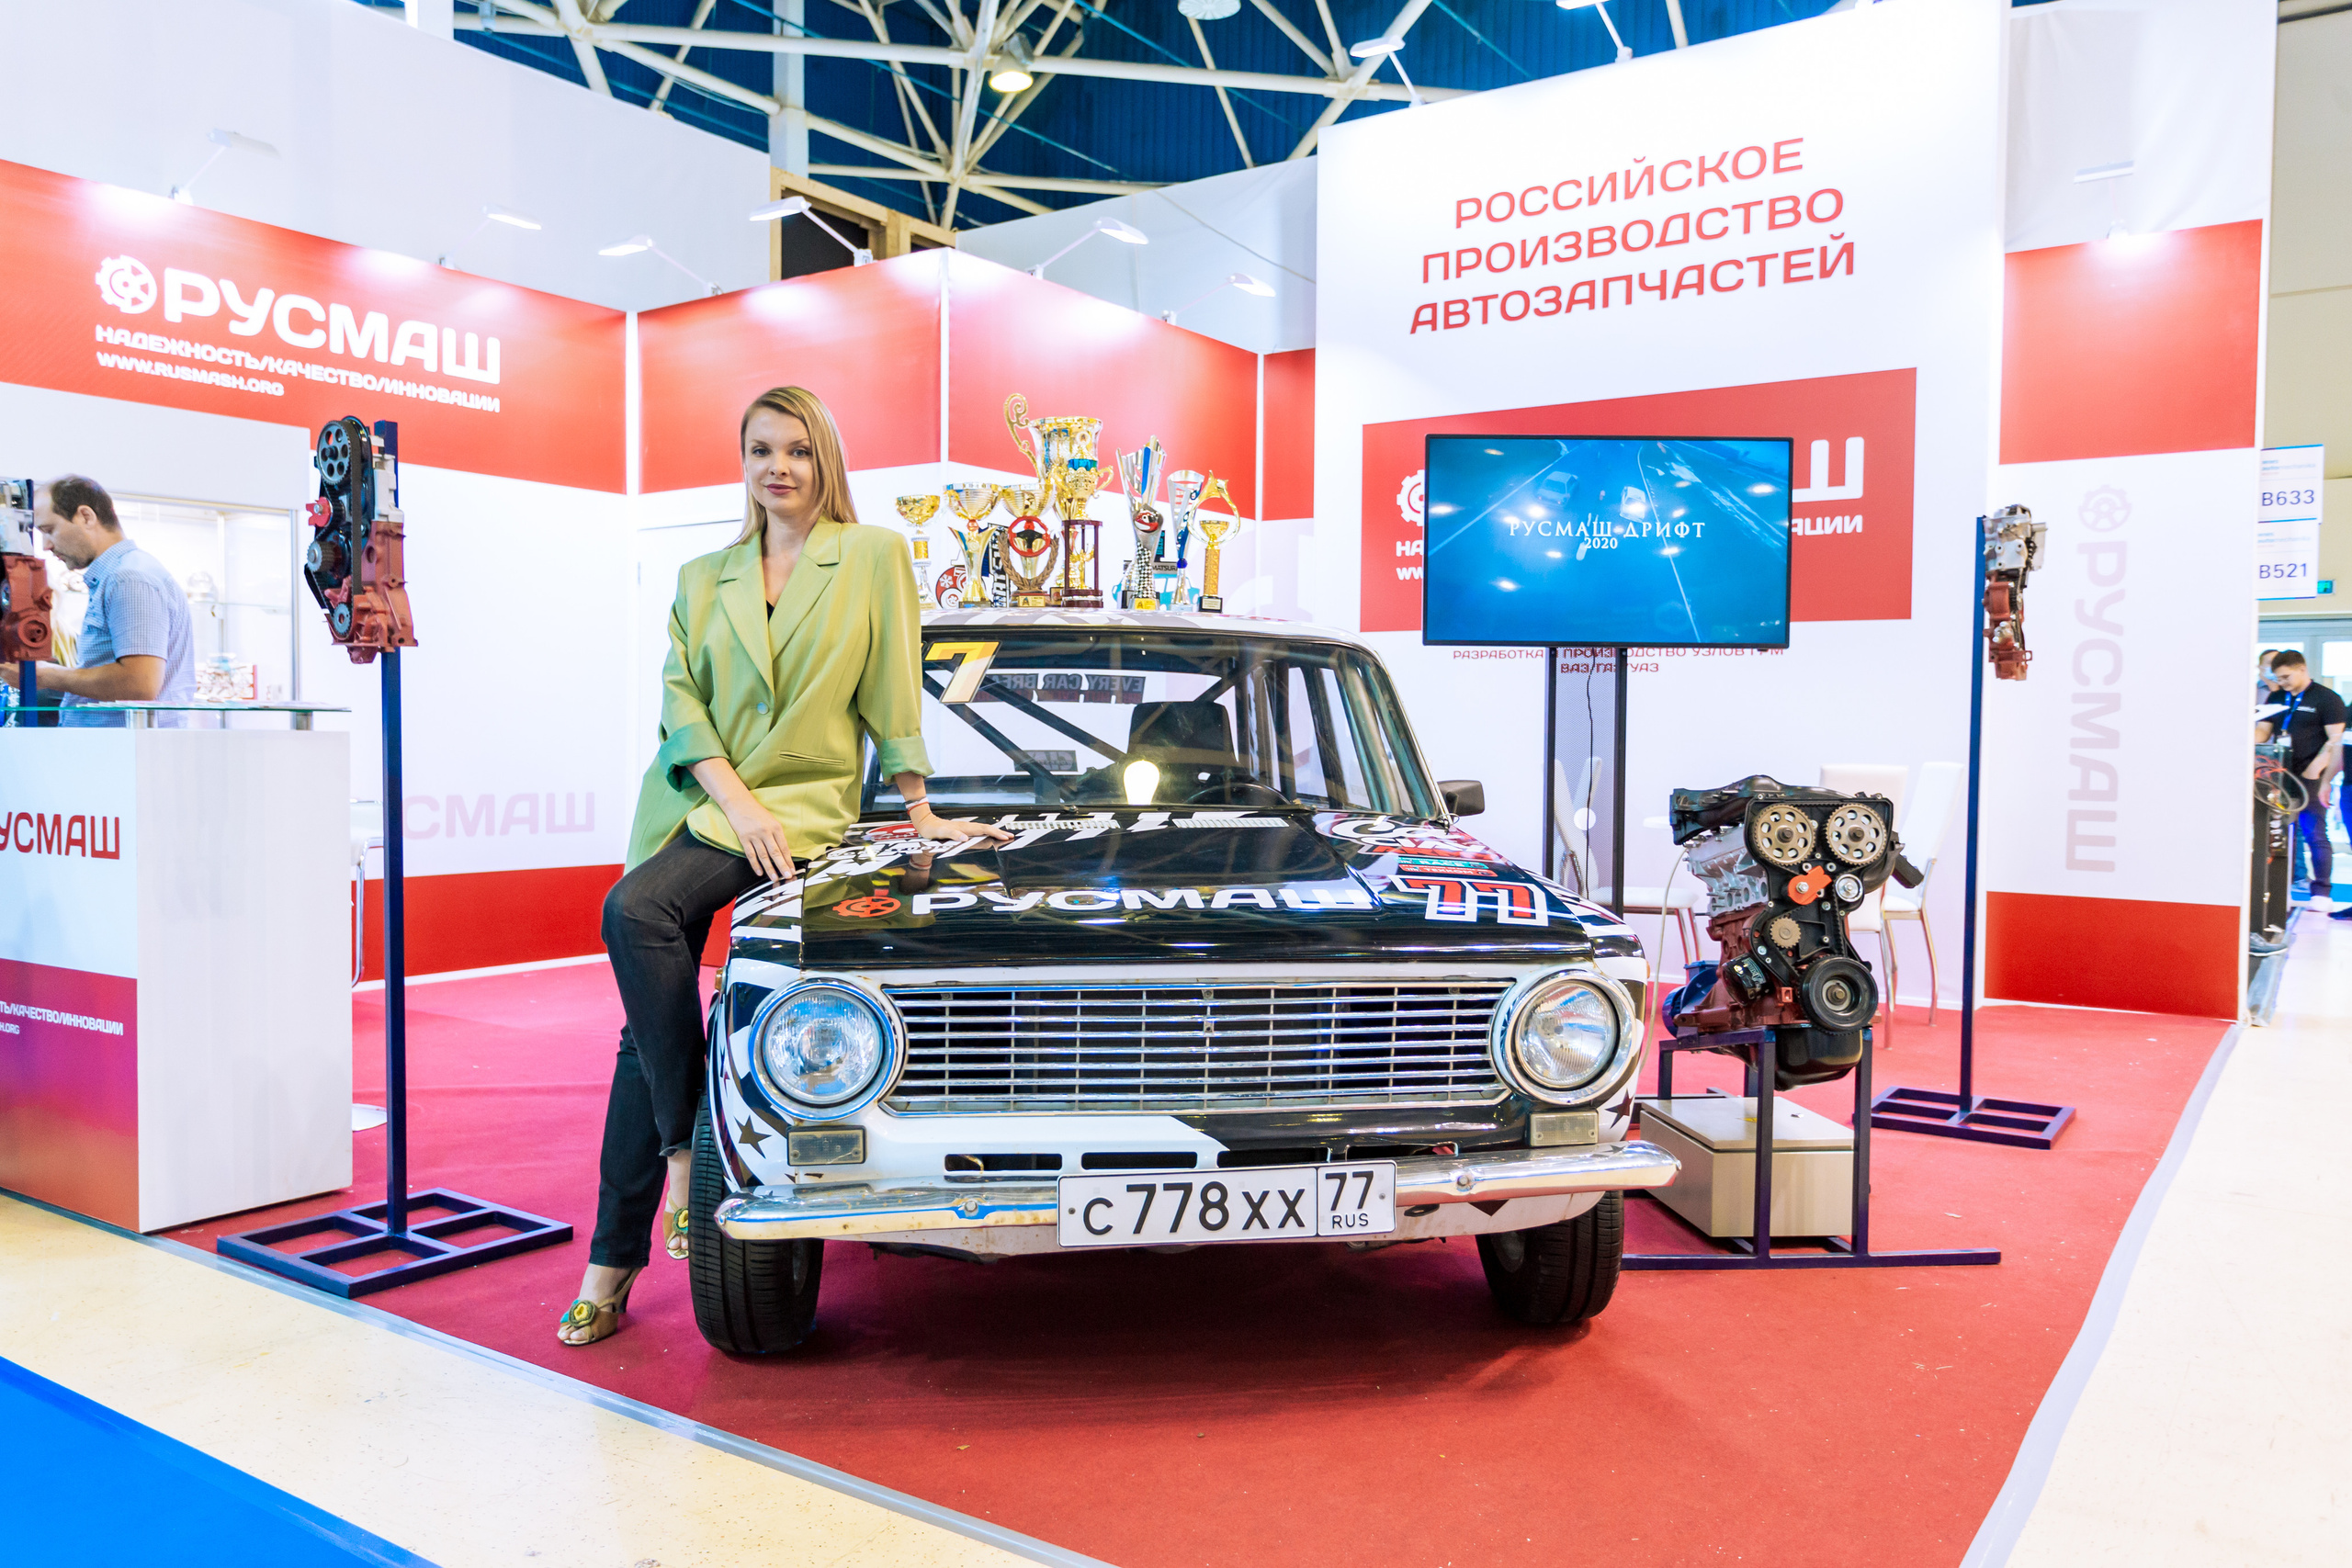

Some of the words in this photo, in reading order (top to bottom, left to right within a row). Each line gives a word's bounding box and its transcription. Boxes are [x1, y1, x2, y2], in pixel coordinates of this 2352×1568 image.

[1455, 138, 1804, 229] РОССИЙСКОЕ
[1422, 188, 1845, 284] ПРОИЗВОДСТВО
[1410, 234, 1855, 334] АВТОЗАПЧАСТЕЙ
[164, 267, 501, 384] РУСМАШ
[96, 323, 501, 412] НАДЕЖНОСТЬ/КАЧЕСТВО/ИННОВАЦИИ
[96, 351, 285, 396] WWW.RUSMASH.ORG
[2261, 490, 2315, 506] B633
[1510, 521, 1612, 537] РУСМАШ
[1623, 522, 1706, 538] ДРИФТ
[1584, 537, 1618, 549] 2020
[2258, 563, 2308, 579] B521
[922, 640, 1001, 705] 7
[1453, 650, 1544, 660] РАЗРАБОТКА
[2064, 540, 2129, 873] РУСМАШ
[911, 888, 1374, 915] РУСМАШ
[1389, 875, 1549, 926] 77
[1324, 1170, 1374, 1212] 77
[1332, 1213, 1369, 1229] RUS
